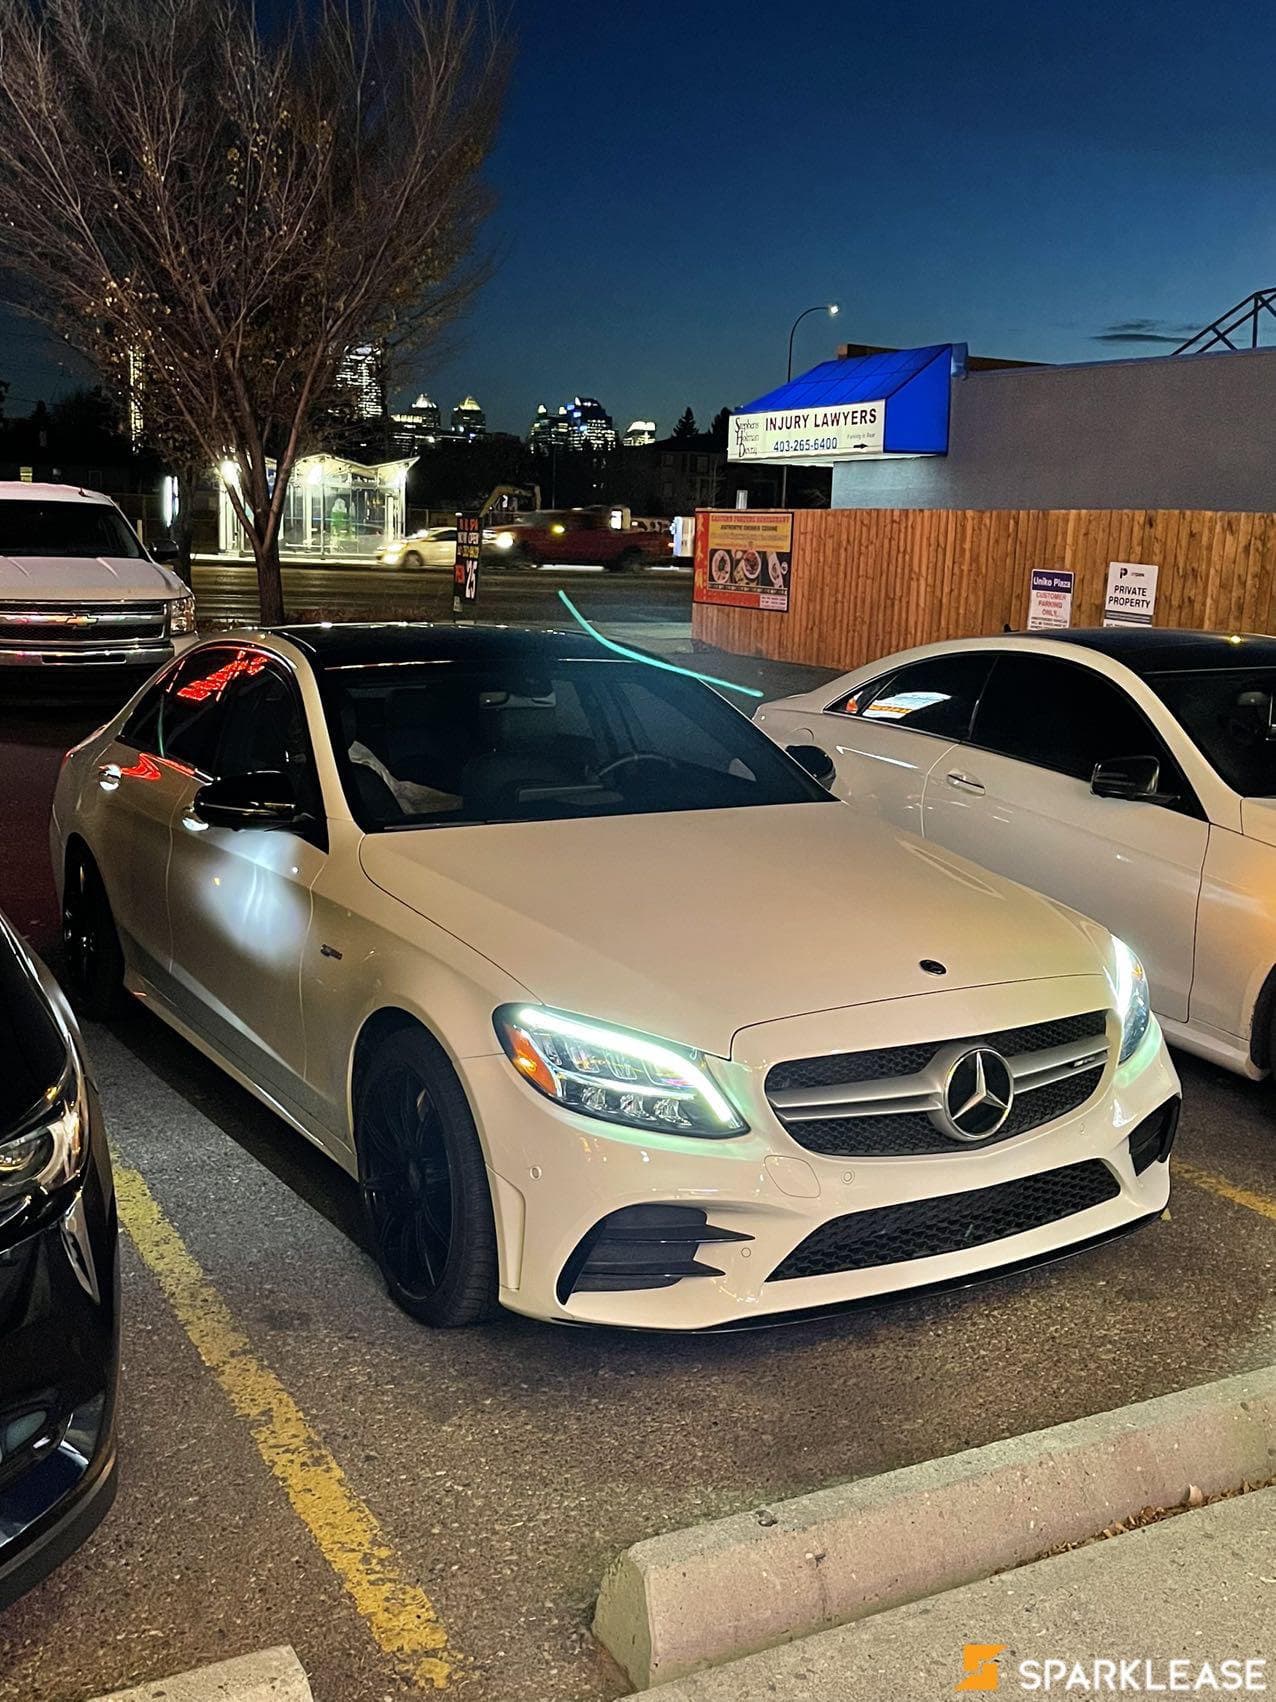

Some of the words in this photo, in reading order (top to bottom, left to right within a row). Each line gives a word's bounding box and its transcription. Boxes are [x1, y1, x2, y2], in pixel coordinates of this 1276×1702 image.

[765, 414, 810, 431] INJURY
[814, 408, 877, 428] LAWYERS
[773, 437, 838, 453] 403-265-6400
[1053, 578, 1071, 588] Plaza
[1036, 592, 1067, 600] CUSTOMER
[1114, 585, 1147, 597] PRIVATE
[1038, 600, 1062, 608] PARKING
[1108, 596, 1151, 608] PROPERTY
